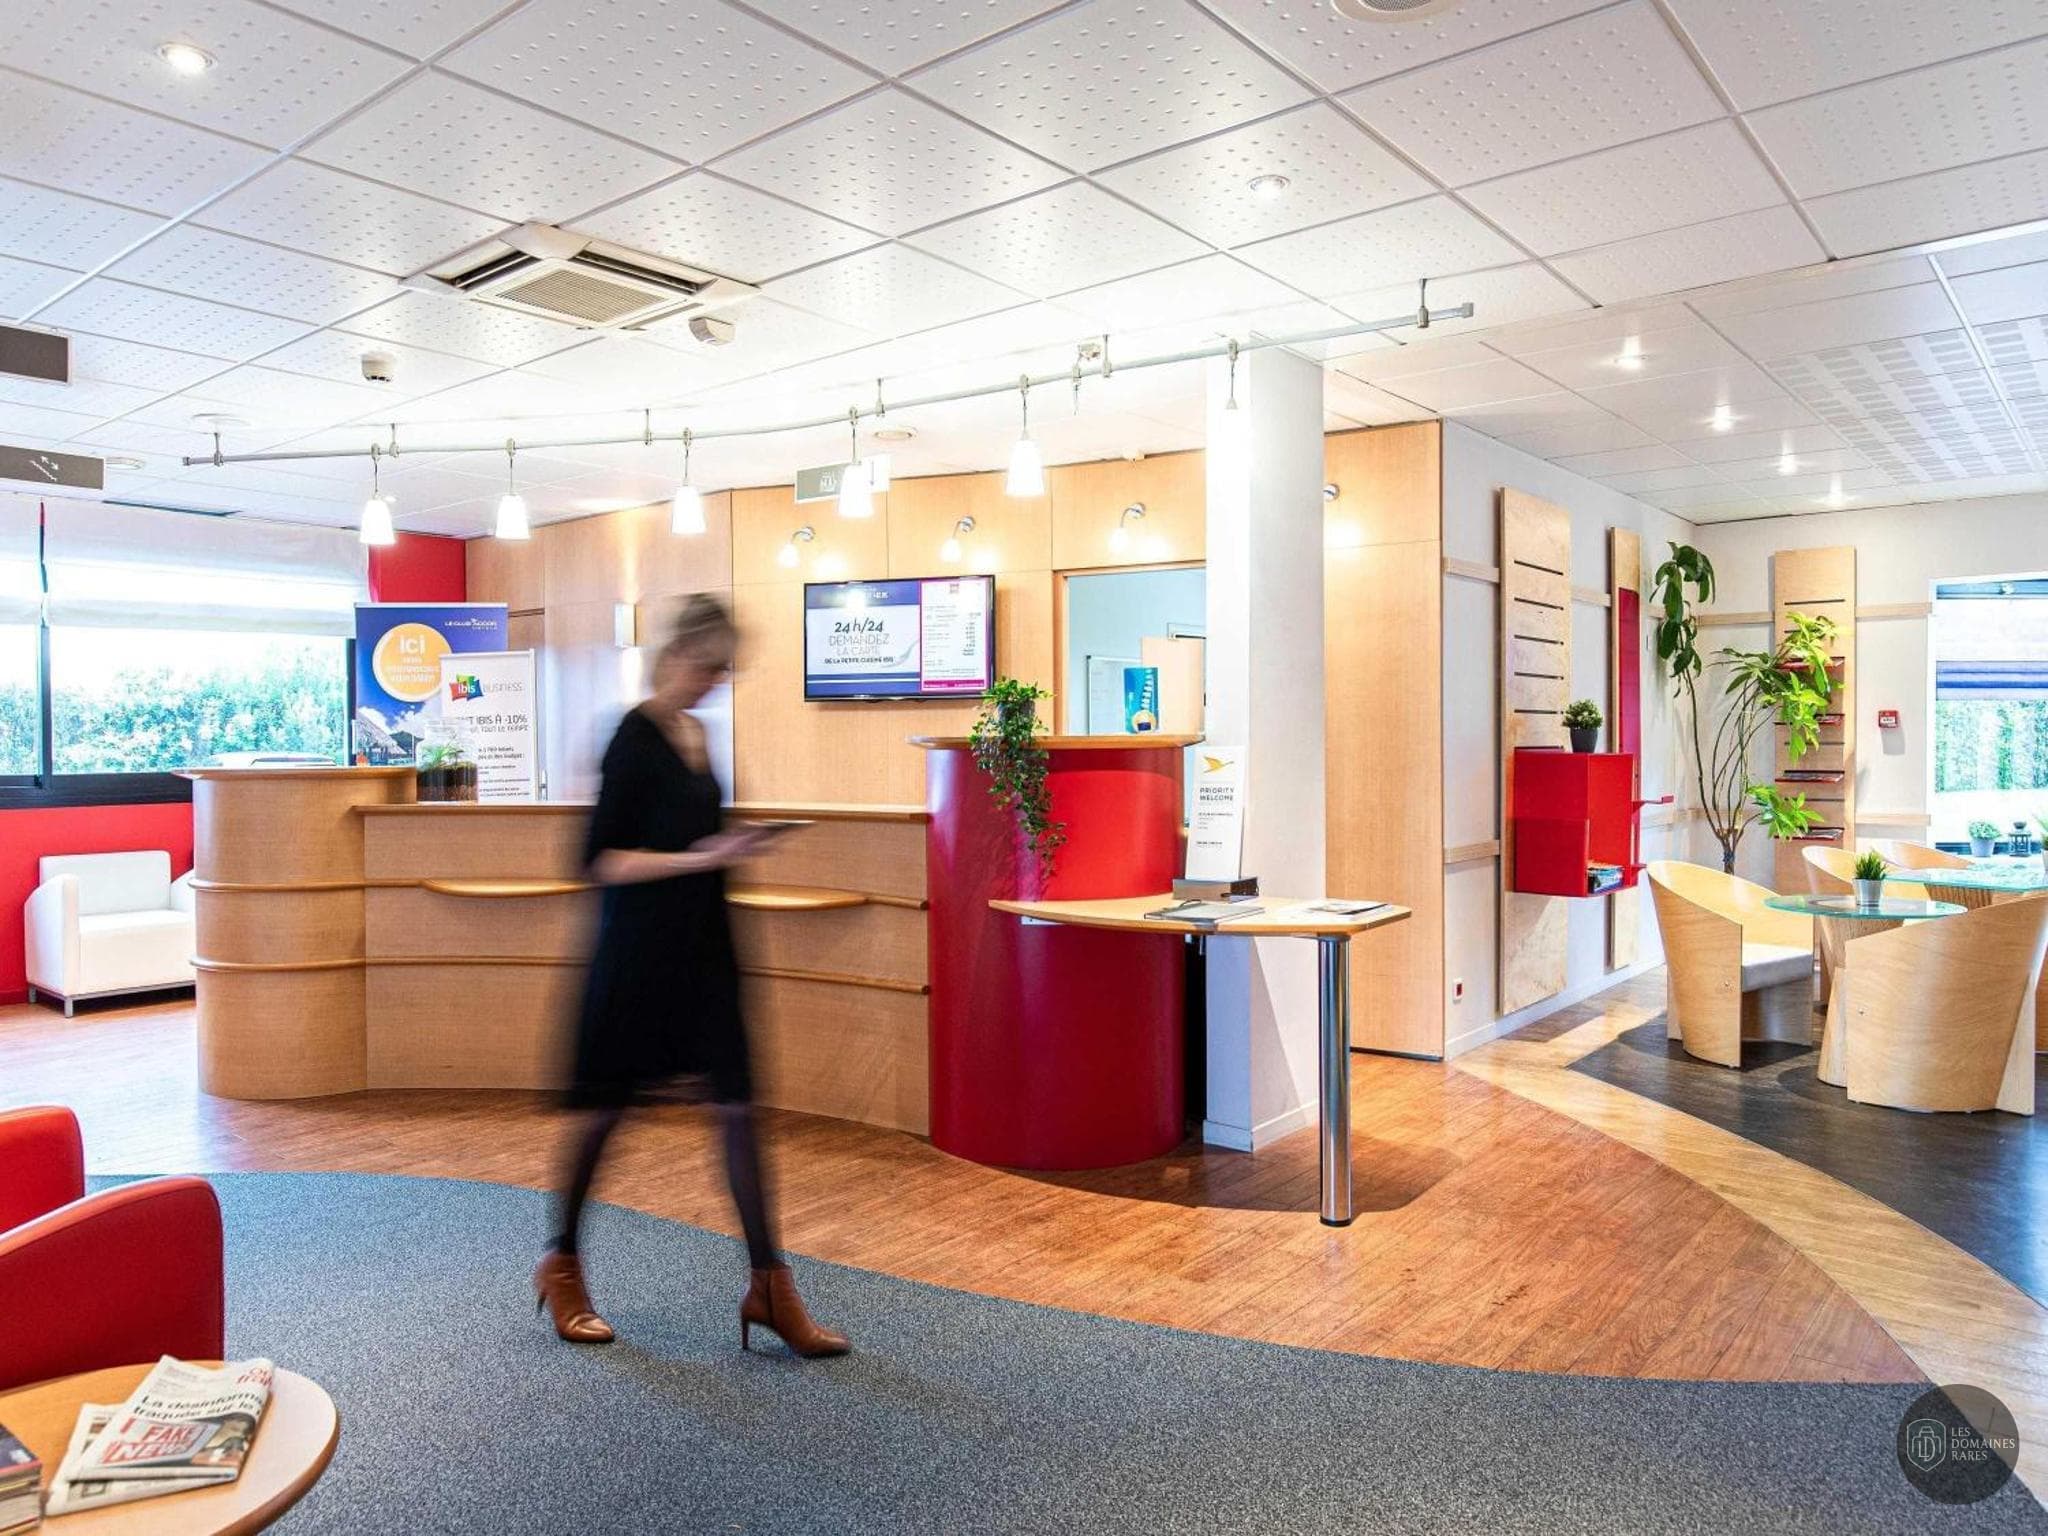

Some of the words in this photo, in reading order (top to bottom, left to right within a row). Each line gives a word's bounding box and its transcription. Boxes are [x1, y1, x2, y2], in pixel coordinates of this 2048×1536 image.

[829, 633, 890, 646] DEMANDEZ
[458, 681, 476, 694] ibis
[141, 1423, 196, 1442] FAKE
